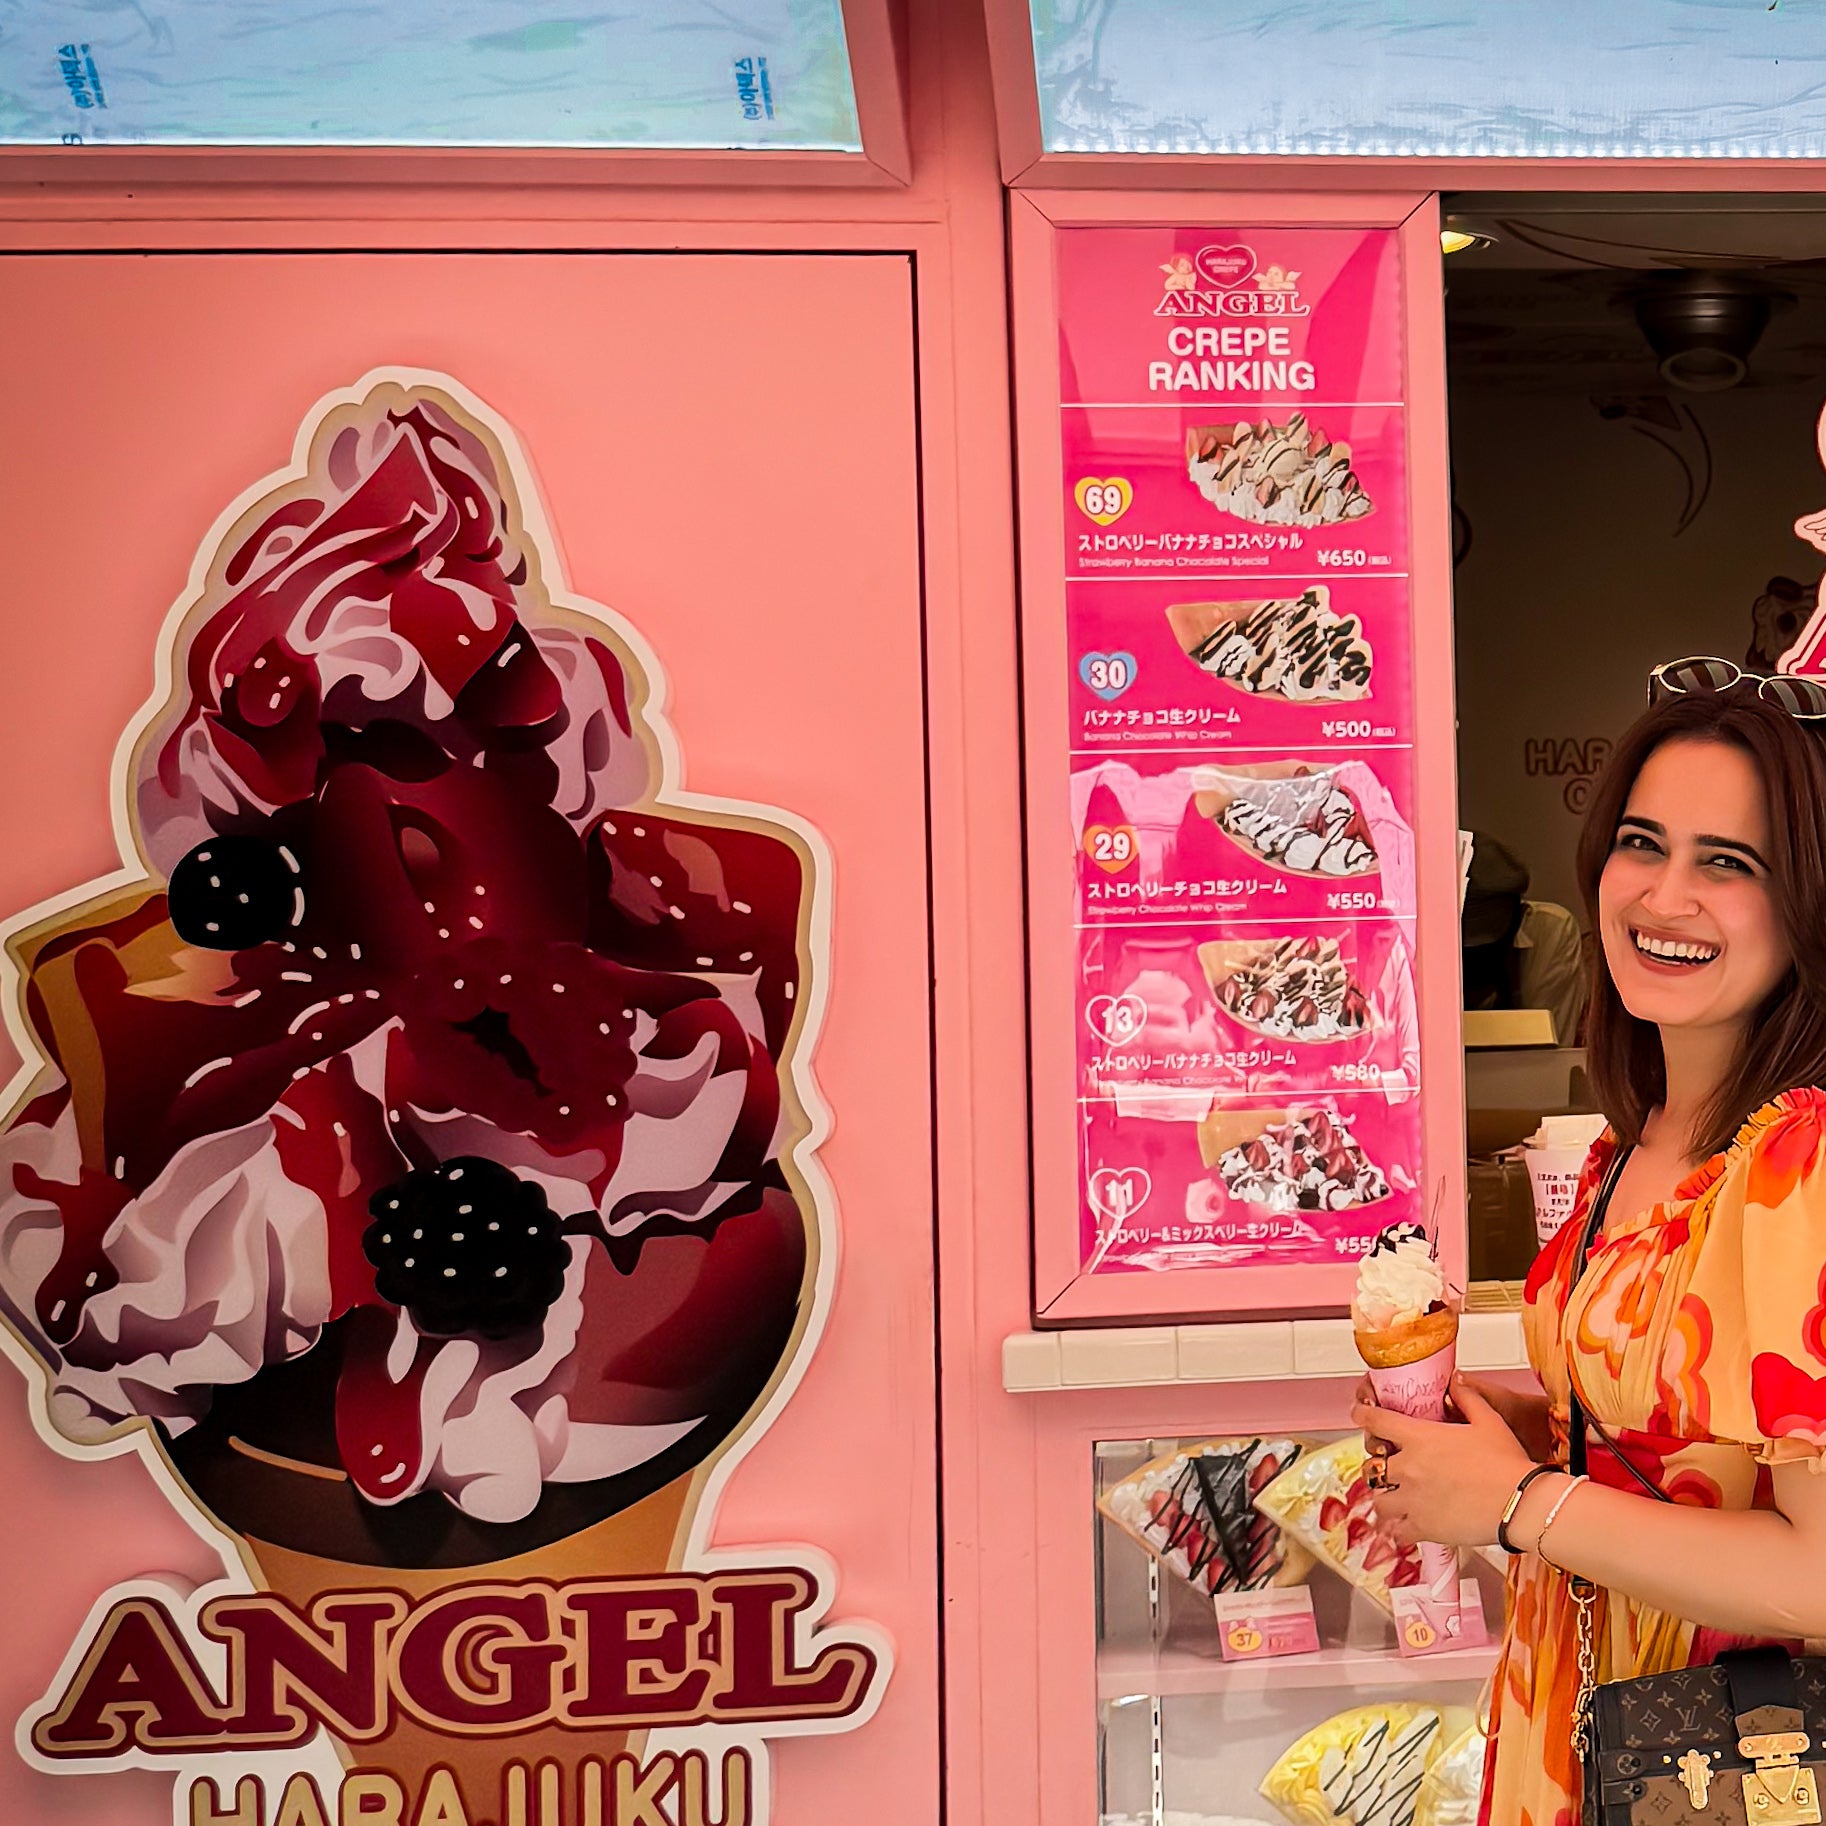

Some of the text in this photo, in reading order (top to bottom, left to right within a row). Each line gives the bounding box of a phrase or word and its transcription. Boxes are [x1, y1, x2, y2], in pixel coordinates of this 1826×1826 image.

[1153, 290, 1311, 317] ANGEL
[1167, 326, 1292, 357] CREPE
[1148, 361, 1316, 391] RANKING
[1084, 485, 1124, 515] 69
[1078, 532, 1304, 551] ストロベリーバナナチョコスペシャル
[1317, 550, 1367, 567] ¥650
[1090, 660, 1128, 691] 30
[1083, 707, 1241, 726] バナナチョコ生クリーム
[1321, 720, 1372, 739] ¥500
[1094, 833, 1131, 860] 29
[1327, 892, 1376, 911] ¥550
[1101, 1005, 1134, 1034] 13
[1235, 1632, 1253, 1646] 37
[1413, 1627, 1428, 1642] 10
[31, 1566, 879, 1760] ANGEL
